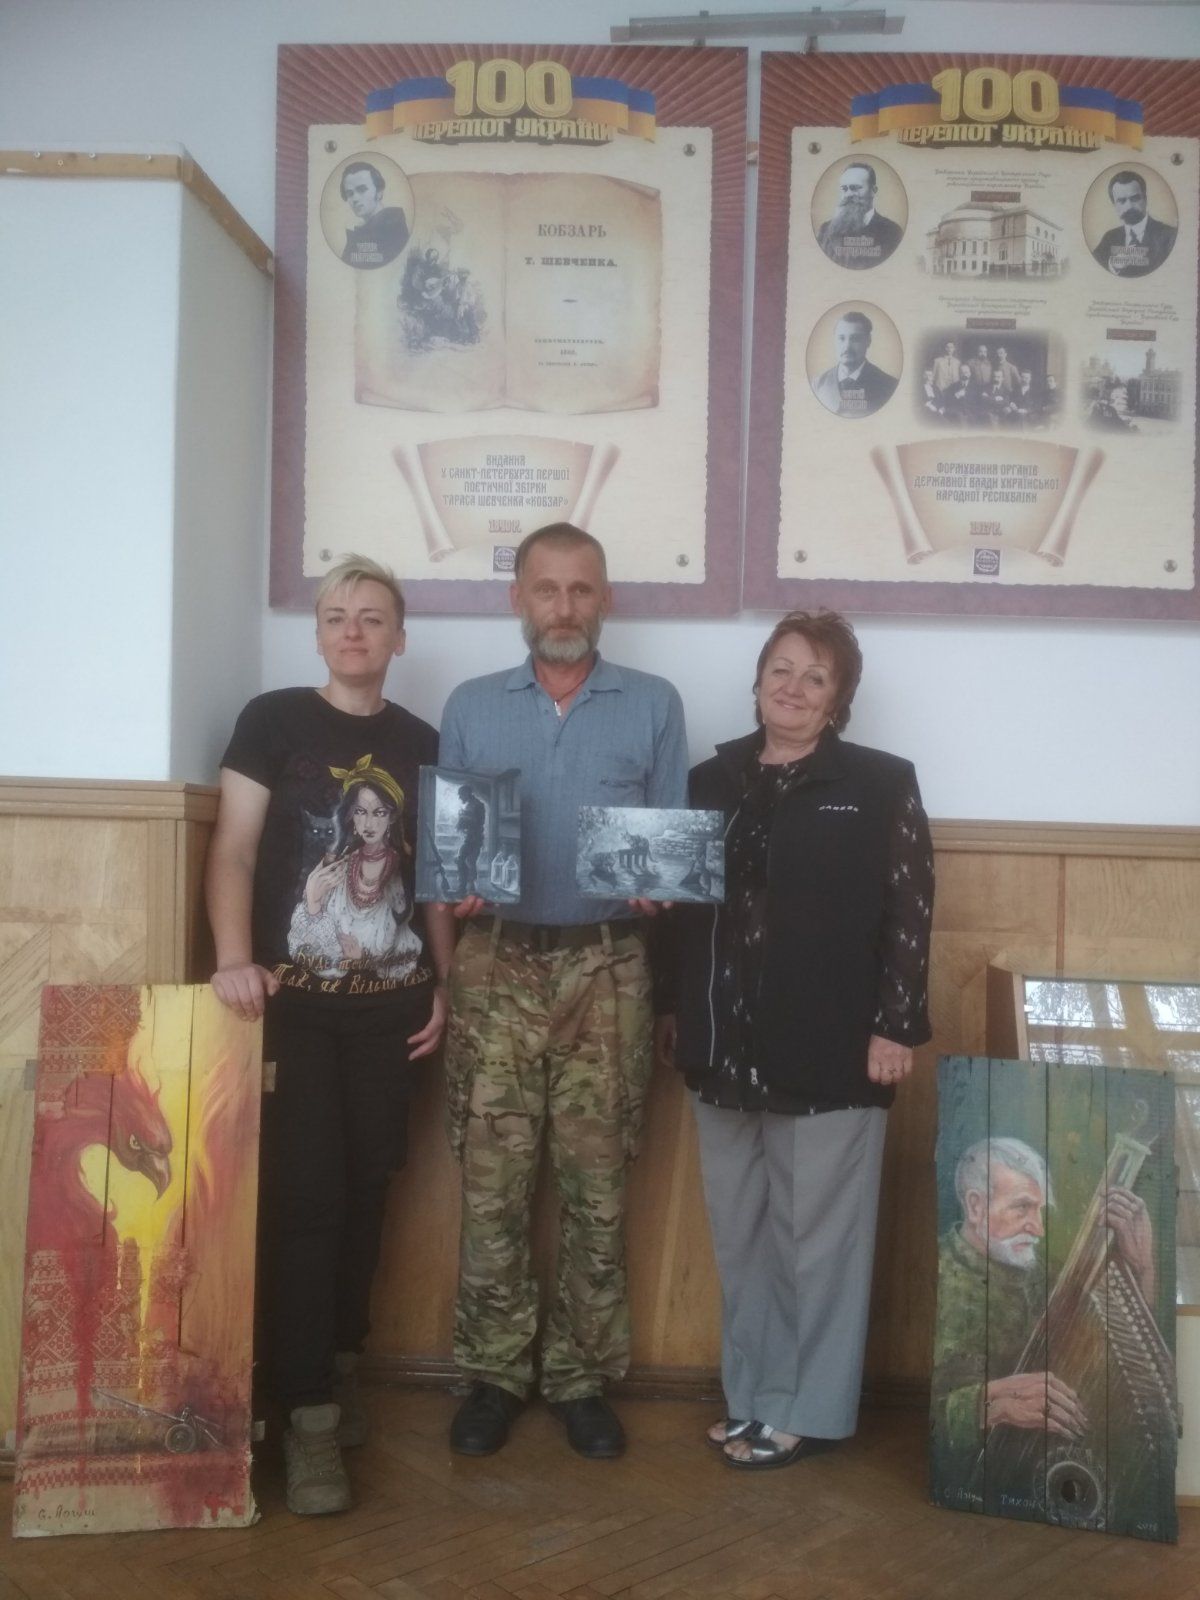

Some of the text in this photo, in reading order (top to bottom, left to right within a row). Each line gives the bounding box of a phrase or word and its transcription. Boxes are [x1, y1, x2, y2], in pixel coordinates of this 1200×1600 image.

[445, 59, 573, 118] 100
[932, 67, 1060, 124] 100
[413, 117, 612, 142] ПЕРЕМОГ УКРАЇНИ
[897, 124, 1100, 148] ПЕРЕМОГ УКРАЇНИ
[538, 224, 608, 238] КОБЗАРЬ
[486, 455, 526, 466] ВИДАННЯ
[441, 468, 570, 480] У САНКТ-ПЕТЕРБУРЗІ ПЕРШОЇ
[937, 462, 1039, 476] ФОРМУВАННЯ ОРГАНІВ
[464, 481, 547, 493] ПОЕТИЧНОЇ ЗБІРКИ
[914, 475, 1059, 490] ДЕРЖАВНОЇ ВЛАДИ УКРАЇНСЬКОЇ
[443, 494, 476, 506] ТАРАСА
[478, 495, 524, 507] ШЕВЧЕНКА
[936, 490, 1038, 504] НАРОДНОЇ РЕСПУБЛІКИ
